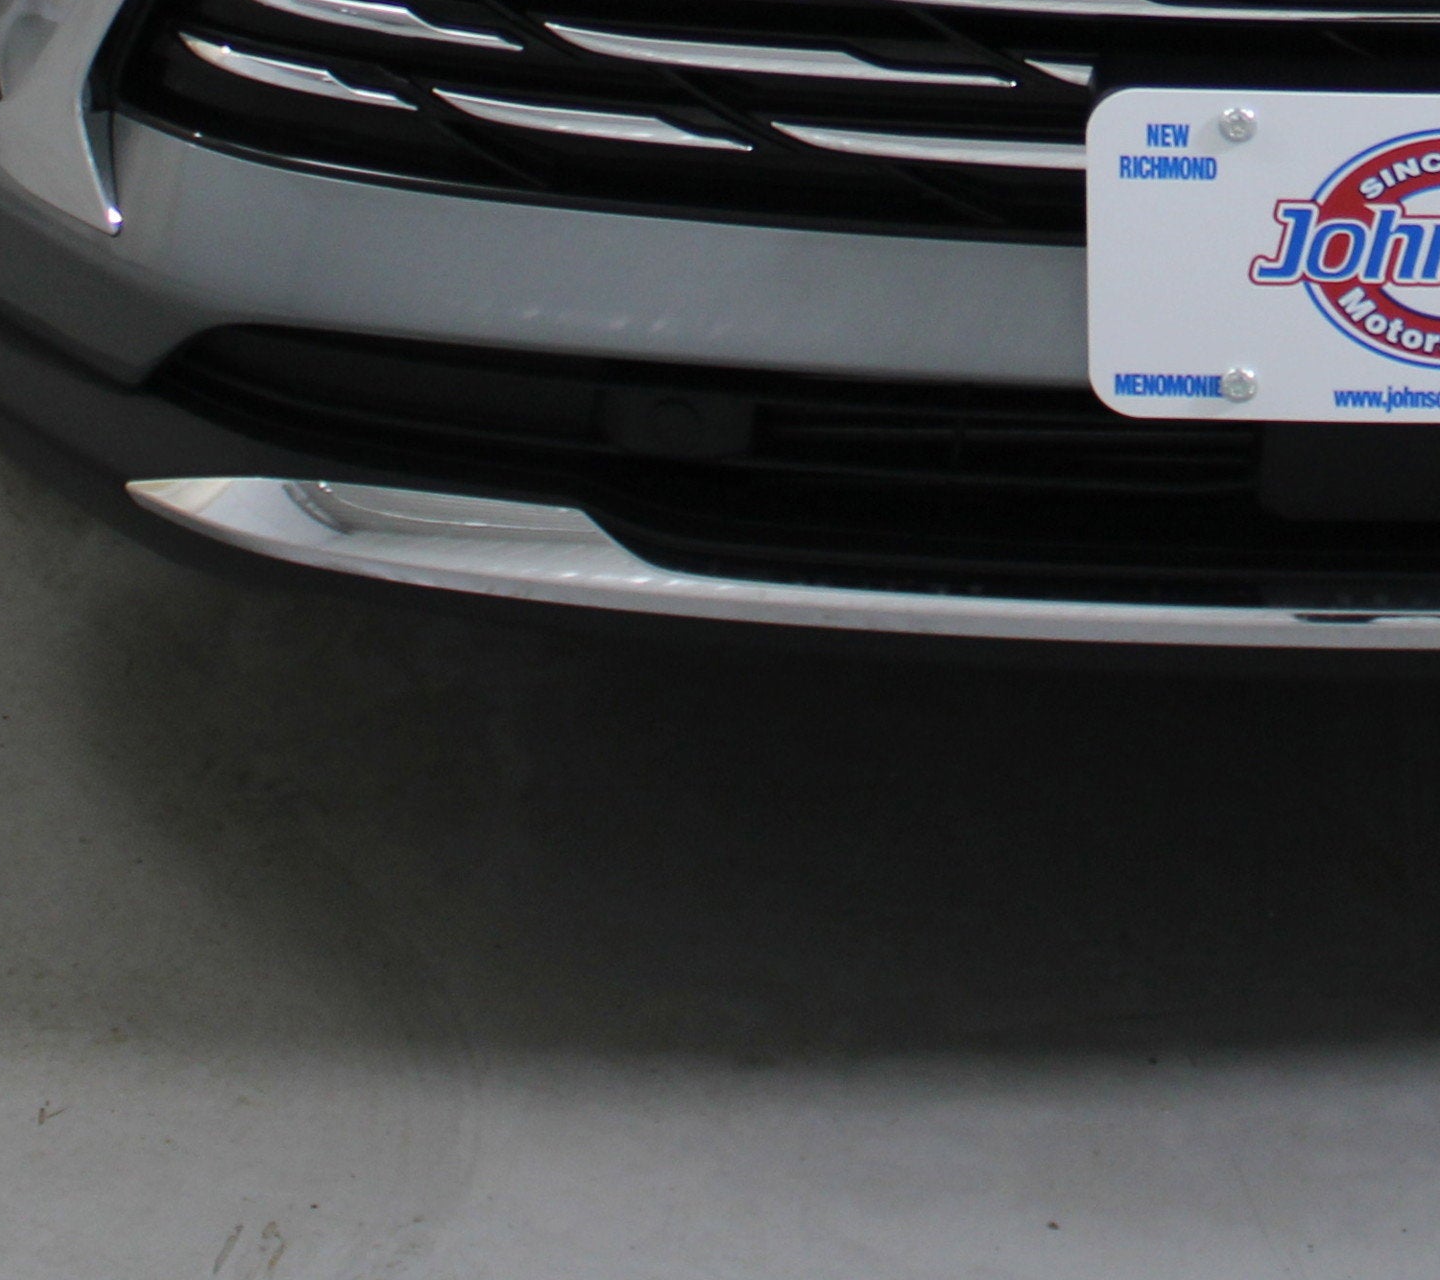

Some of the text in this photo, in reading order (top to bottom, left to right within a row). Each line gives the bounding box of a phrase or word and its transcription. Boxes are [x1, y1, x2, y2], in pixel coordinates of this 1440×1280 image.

[1146, 123, 1190, 148] NEW
[1119, 155, 1218, 181] RICHMOND
[1114, 374, 1223, 398] MENOMONIE
